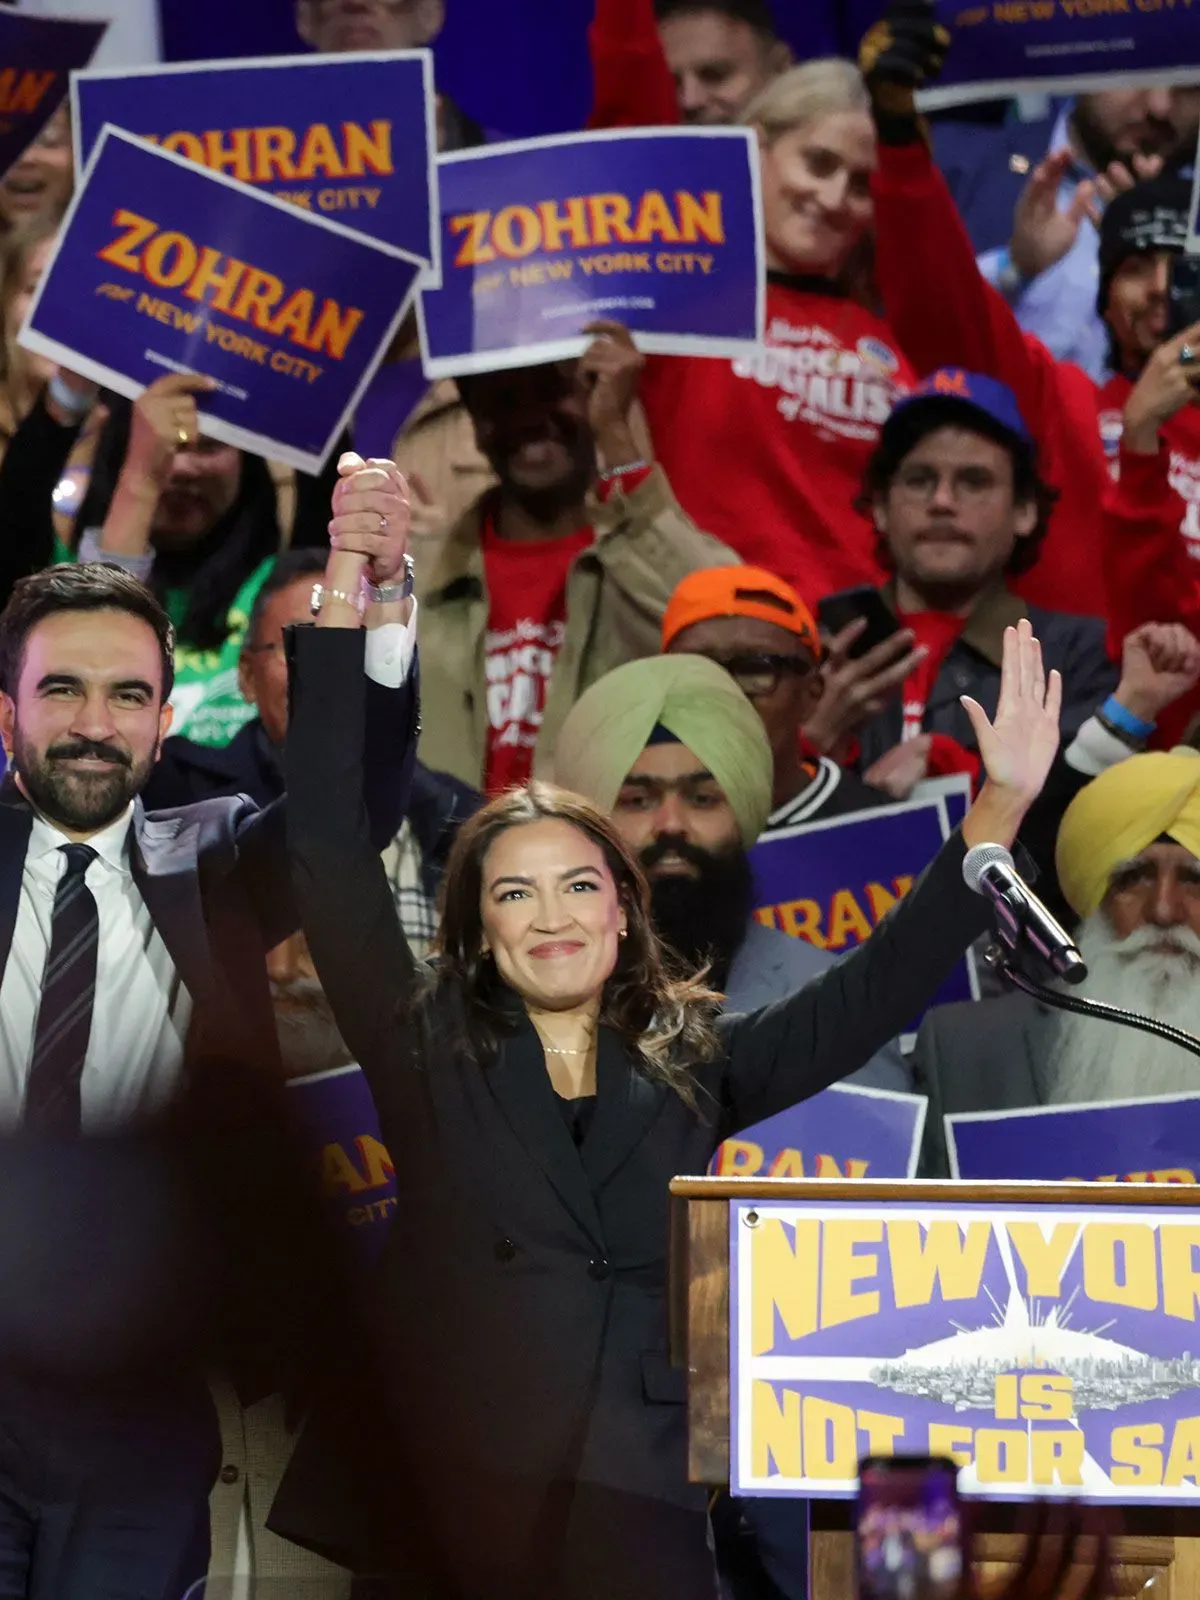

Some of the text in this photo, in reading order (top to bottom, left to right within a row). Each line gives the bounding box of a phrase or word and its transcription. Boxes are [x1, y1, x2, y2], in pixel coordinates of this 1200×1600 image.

[140, 118, 396, 184] OHRAN
[316, 186, 382, 212] CITY
[449, 188, 725, 269] ZOHRAN
[95, 207, 366, 362] ZOHRAN
[508, 257, 574, 289] NEW
[578, 251, 653, 276] YORK
[655, 250, 716, 275] CITY
[135, 291, 205, 335] NEW
[205, 321, 271, 366] YORK
[269, 350, 326, 385] CITY
[751, 1217, 995, 1357] NEW
[751, 1378, 904, 1480] NOT
[928, 1421, 1085, 1485] FOR
[994, 1373, 1074, 1420] IS
